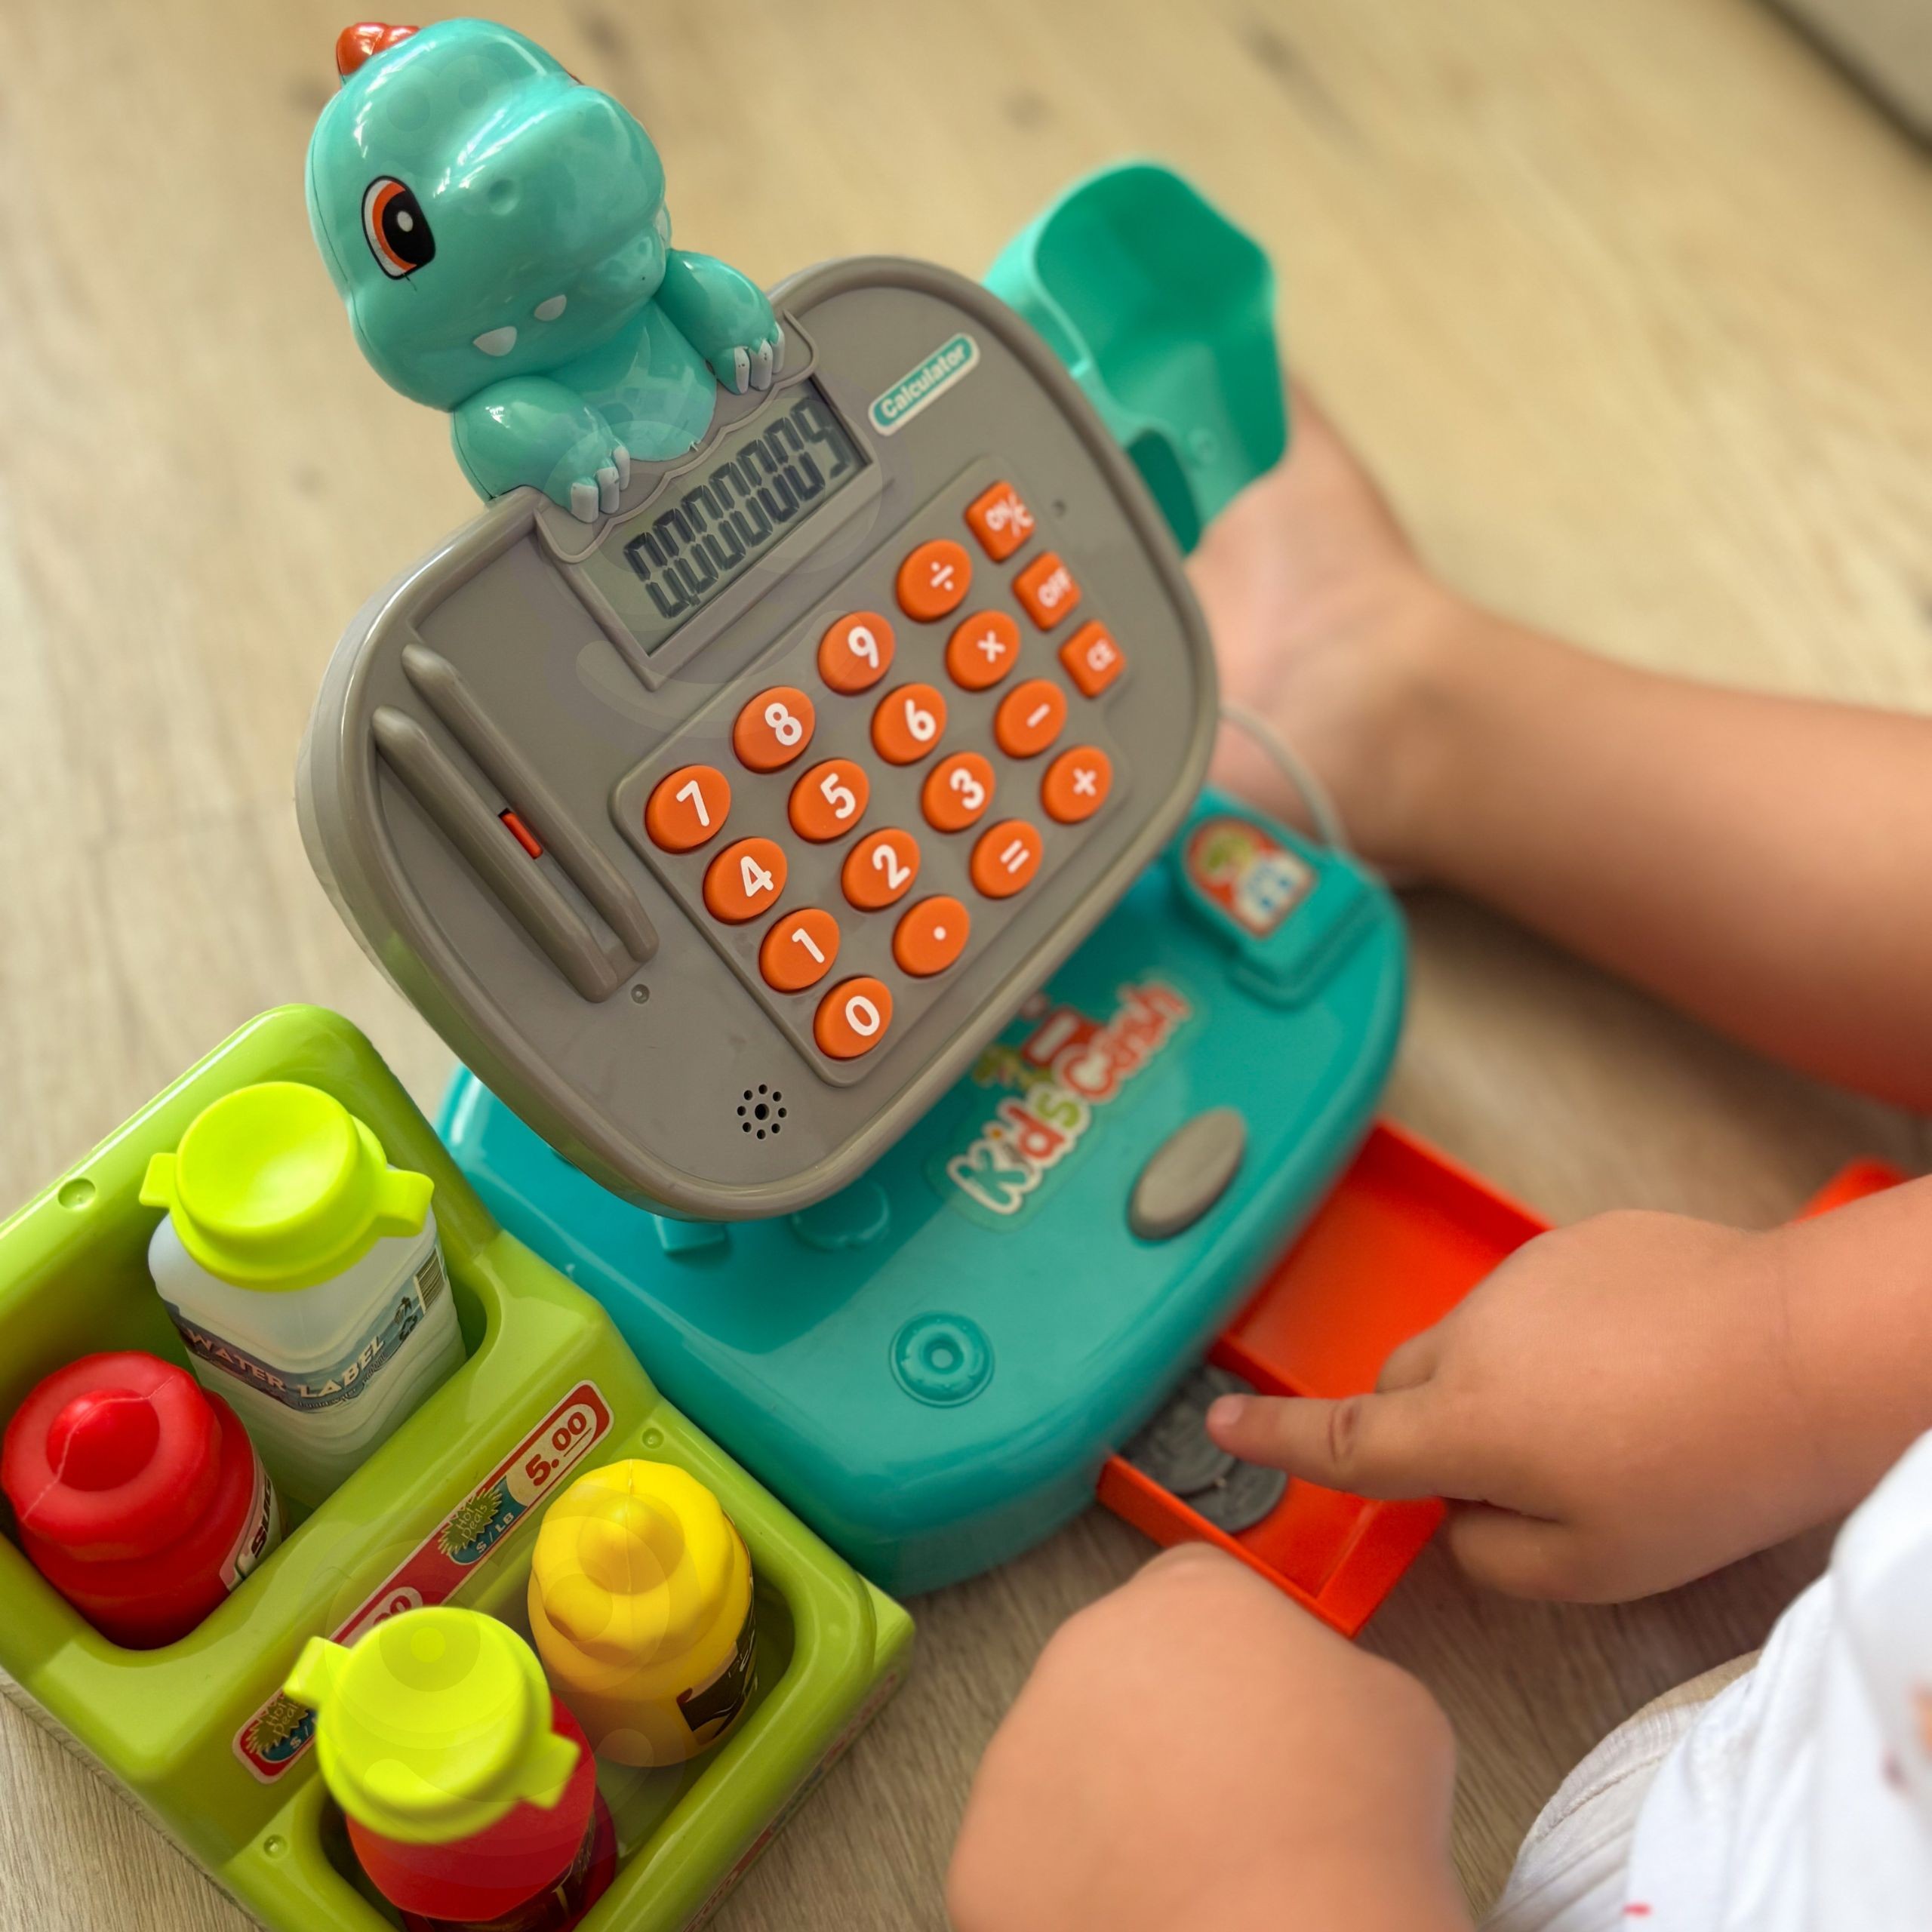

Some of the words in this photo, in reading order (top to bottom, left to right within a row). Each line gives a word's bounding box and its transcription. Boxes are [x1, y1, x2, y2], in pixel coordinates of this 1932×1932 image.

[881, 345, 965, 417] Calculator
[848, 626, 879, 669] 9
[764, 703, 803, 746] 8
[905, 700, 936, 741] 6
[675, 780, 710, 826] 7
[820, 773, 856, 819] 5
[950, 768, 985, 810] 3
[740, 856, 774, 897] 4
[872, 844, 911, 889] 2
[792, 928, 825, 963] 1
[845, 995, 881, 1036] 0
[183, 1324, 287, 1392] WATER
[297, 1335, 385, 1398] LABEL
[525, 1412, 586, 1486] 5.00
[461, 1505, 488, 1540] Deals
